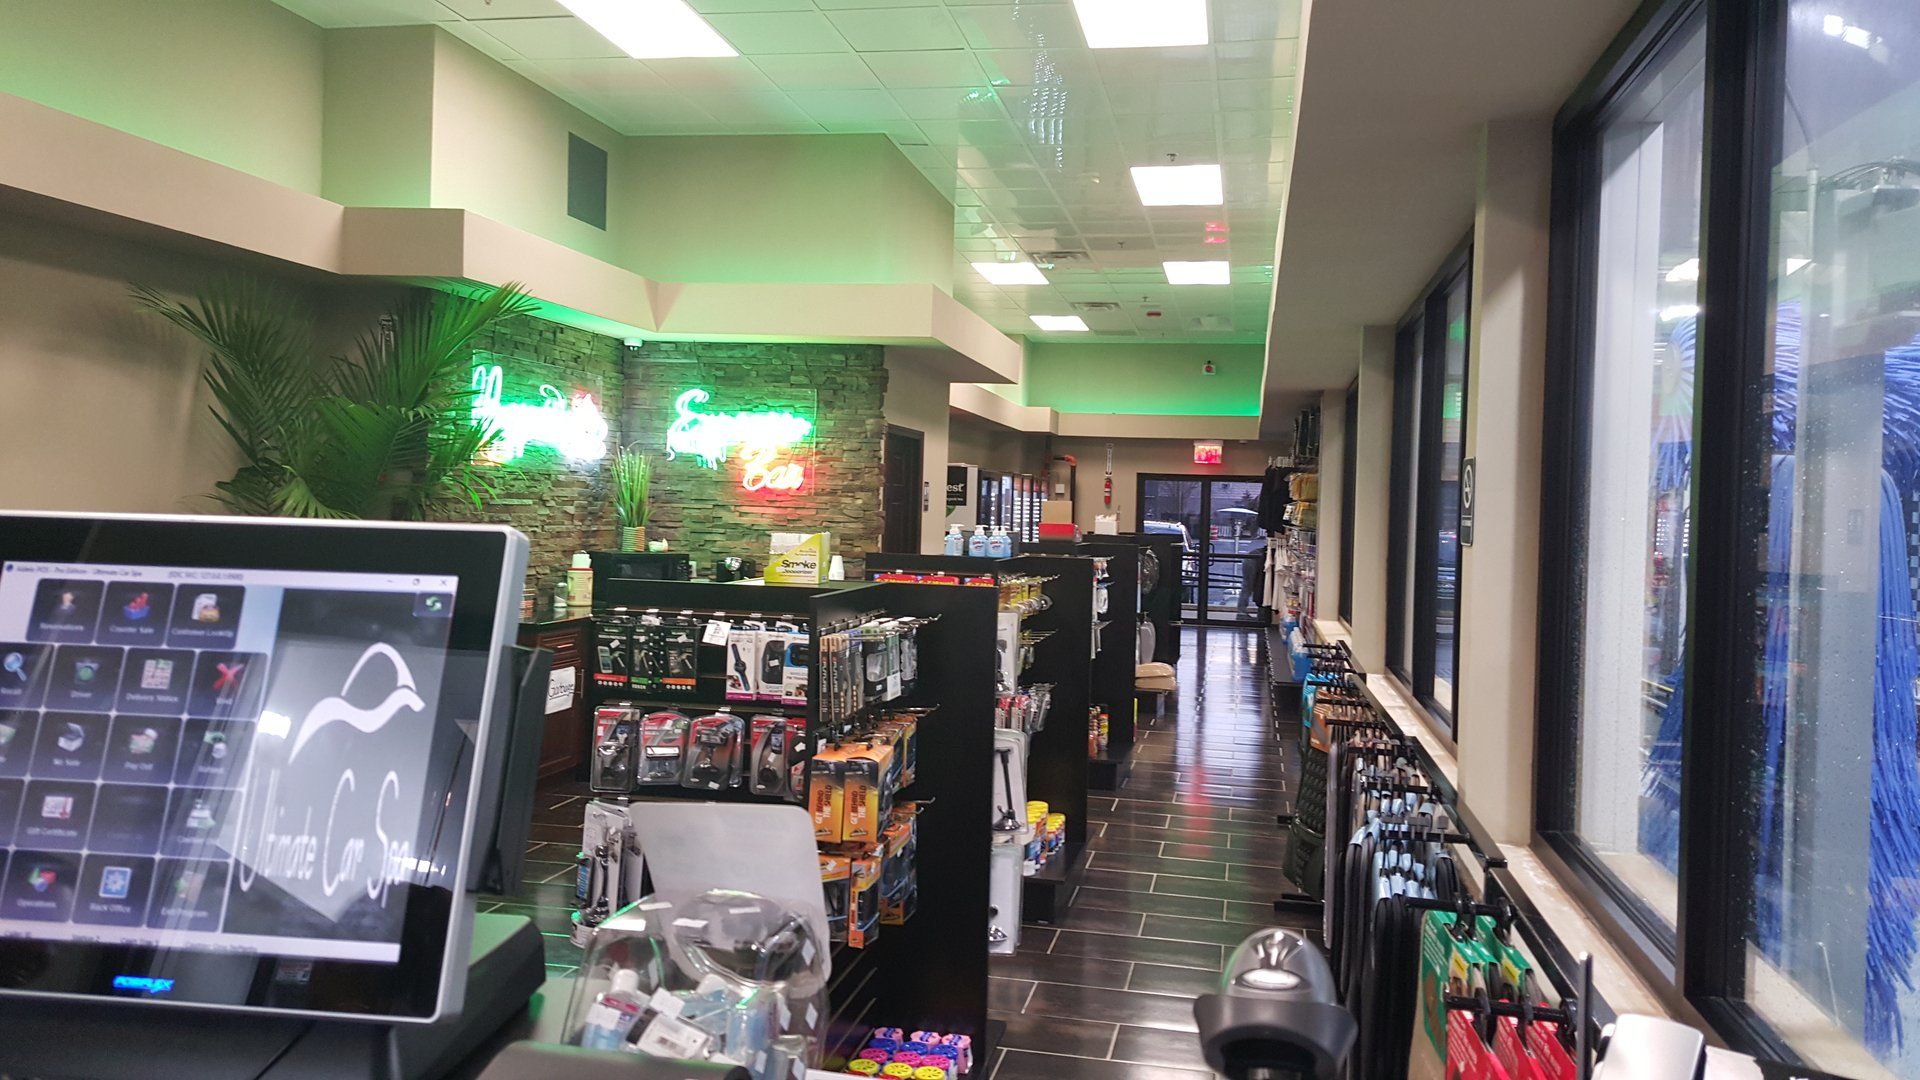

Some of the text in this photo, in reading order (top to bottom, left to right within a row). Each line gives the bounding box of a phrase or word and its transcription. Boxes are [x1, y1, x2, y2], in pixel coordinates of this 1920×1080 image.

[781, 559, 817, 570] Smoke
[815, 789, 824, 824] GET BEHIND
[823, 784, 832, 818] THE SHIELD
[850, 790, 859, 825] GET BEHIND
[857, 785, 867, 818] THE SHIELD
[238, 768, 410, 908] Ultimate Car Spa
